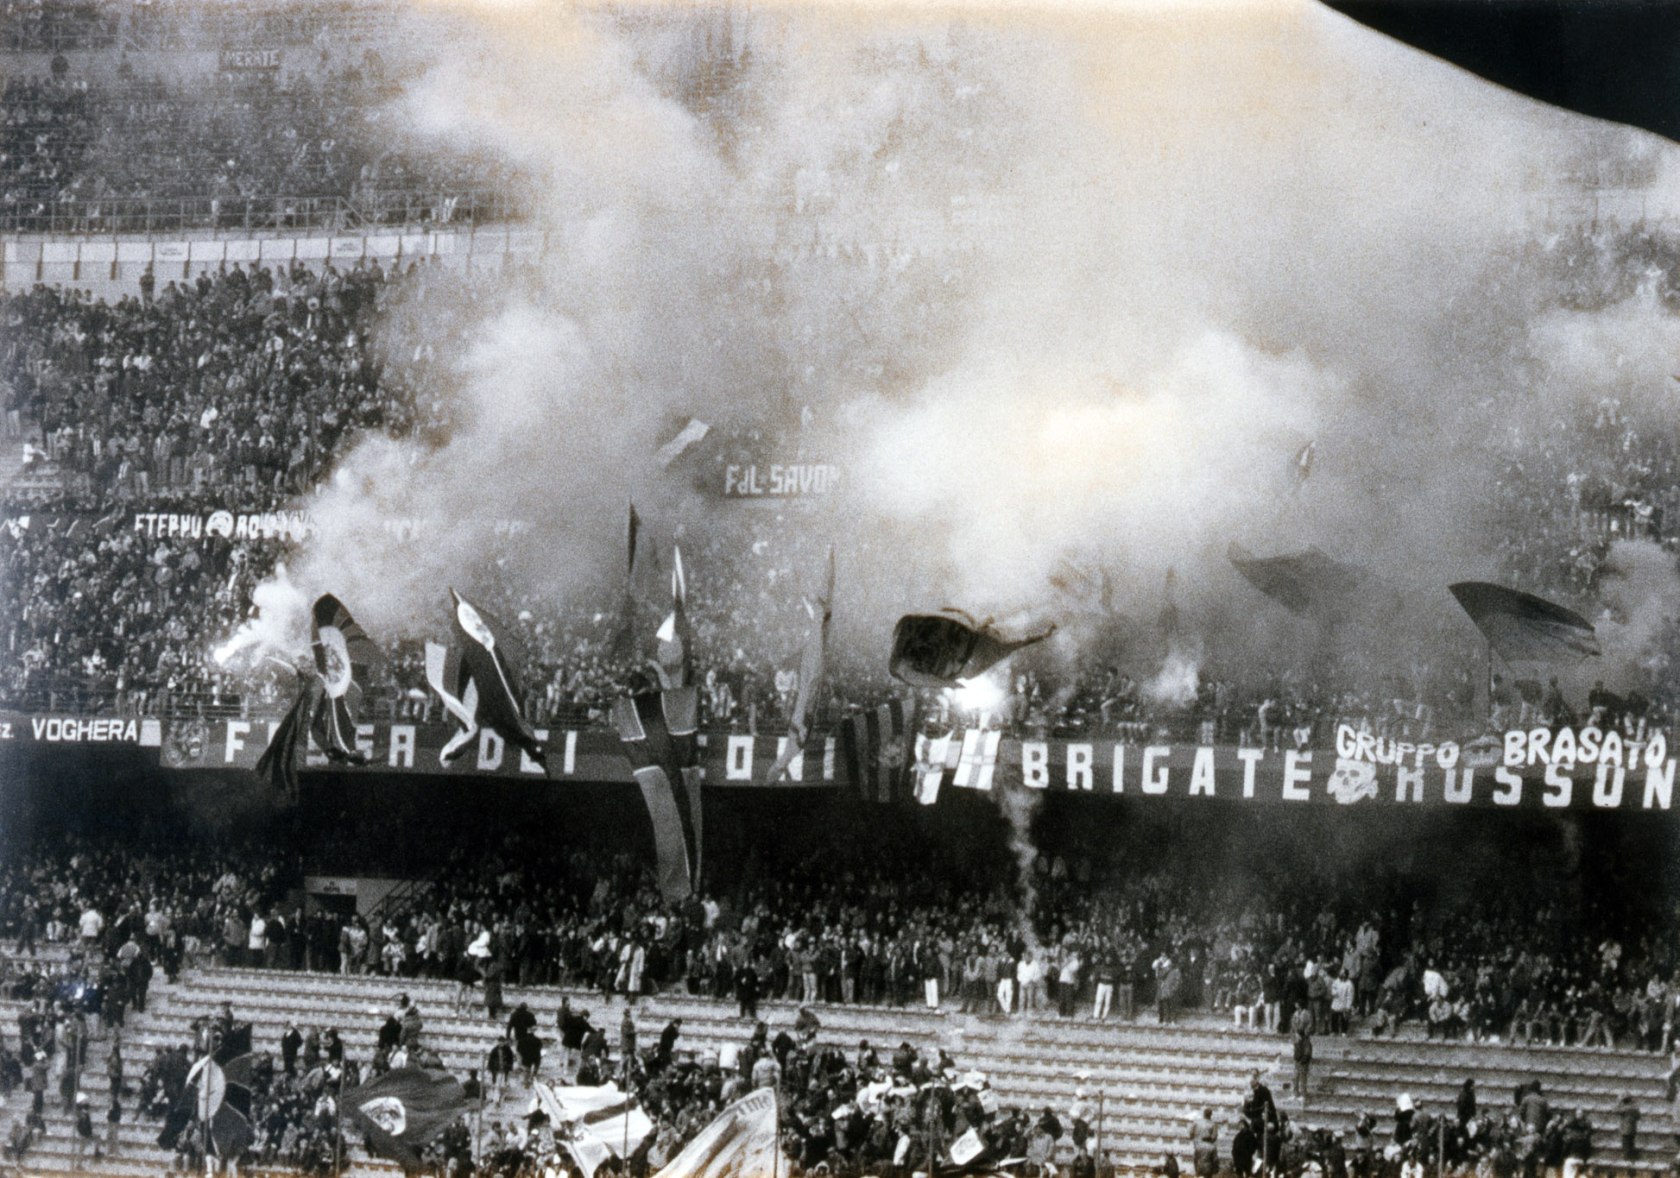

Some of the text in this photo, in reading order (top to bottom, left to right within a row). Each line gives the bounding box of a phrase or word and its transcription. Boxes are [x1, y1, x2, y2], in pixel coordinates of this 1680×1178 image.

[31, 717, 137, 742] VOGHERA
[1336, 724, 1666, 770] GRUPPO BRASATO
[1022, 742, 1312, 801] BRIGATE
